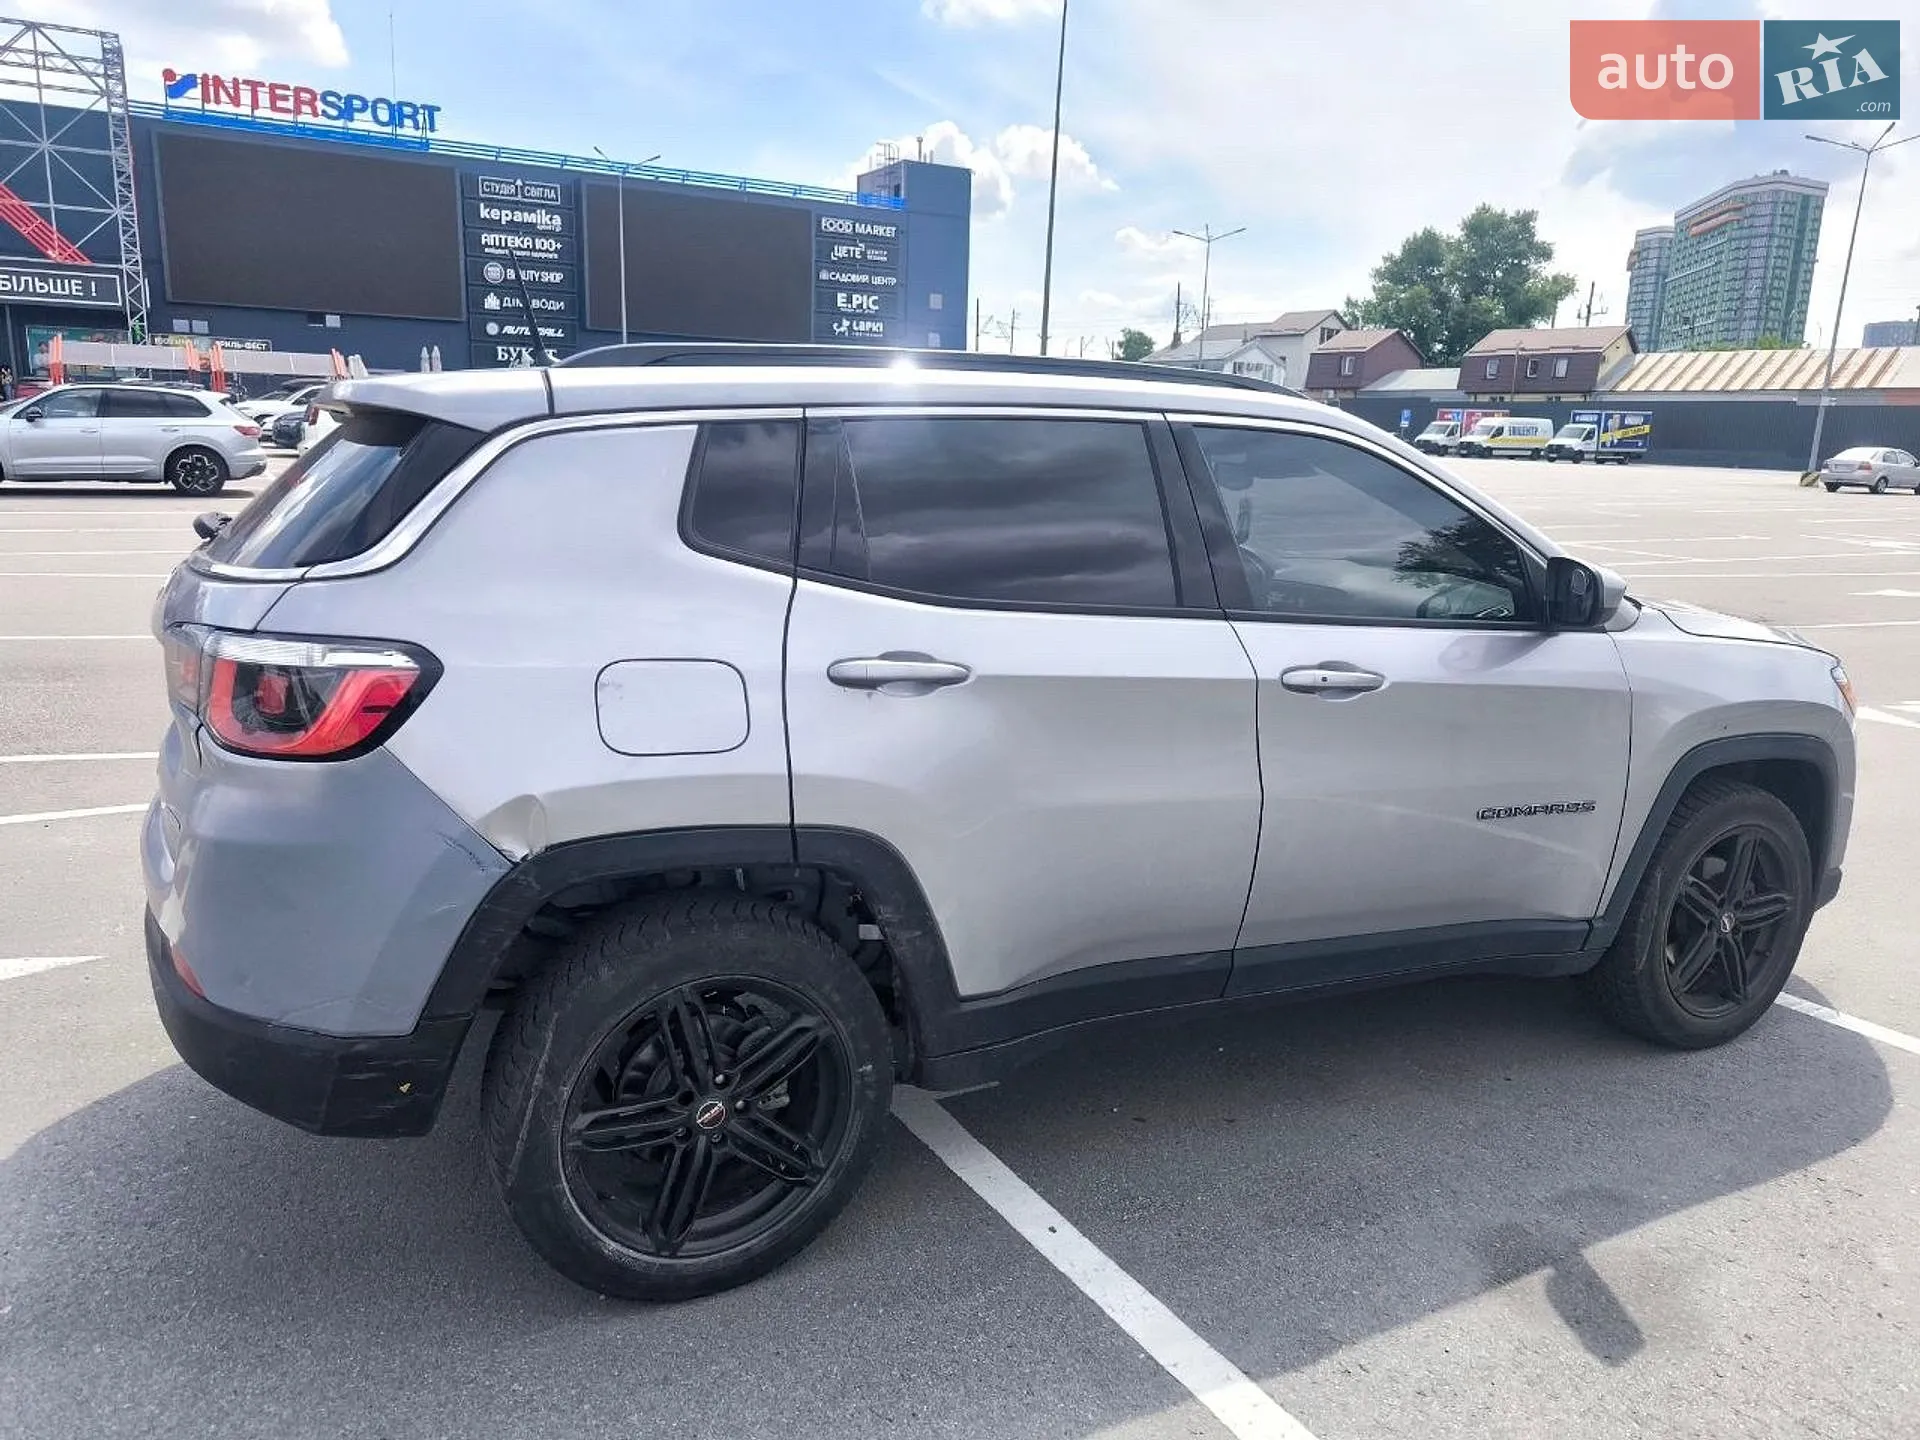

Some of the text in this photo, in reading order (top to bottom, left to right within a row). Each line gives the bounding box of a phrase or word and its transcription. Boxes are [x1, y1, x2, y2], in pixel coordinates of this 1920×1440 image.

[201, 72, 442, 133] INTERSPORT
[483, 181, 516, 195] СТУДІЯ
[822, 217, 897, 238] FOOD MARKET
[482, 233, 562, 251] АПТЕКА 100+
[0, 274, 84, 296] БІЛЬШЕ
[540, 271, 564, 283] SHOP
[837, 292, 879, 310] E.PIC
